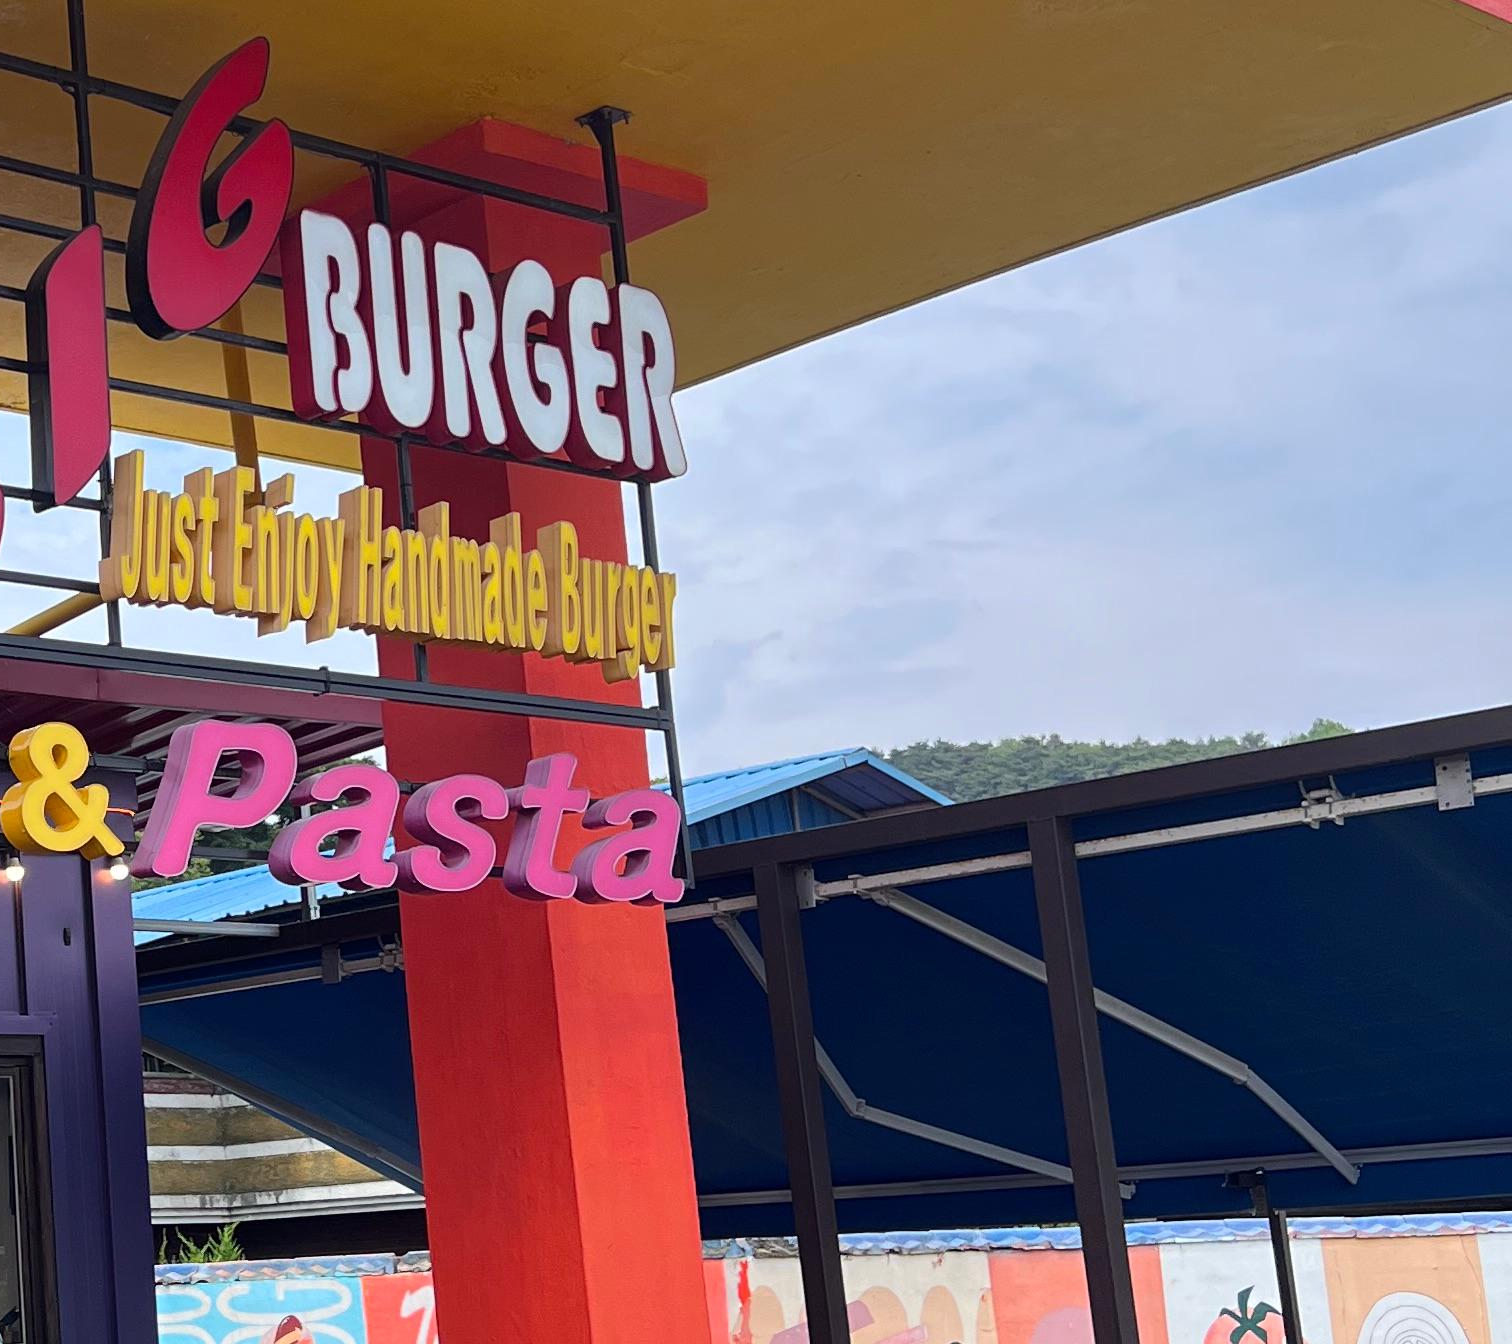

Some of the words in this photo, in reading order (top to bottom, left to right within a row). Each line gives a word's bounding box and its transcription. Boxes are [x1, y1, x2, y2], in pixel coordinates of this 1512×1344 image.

[285, 209, 687, 480] BURGER
[102, 449, 219, 606] Just
[220, 466, 345, 642] Enjoy
[344, 485, 548, 652] Handmade
[544, 521, 676, 681] Burger
[1, 722, 125, 859] &
[136, 720, 686, 903] Pasta
